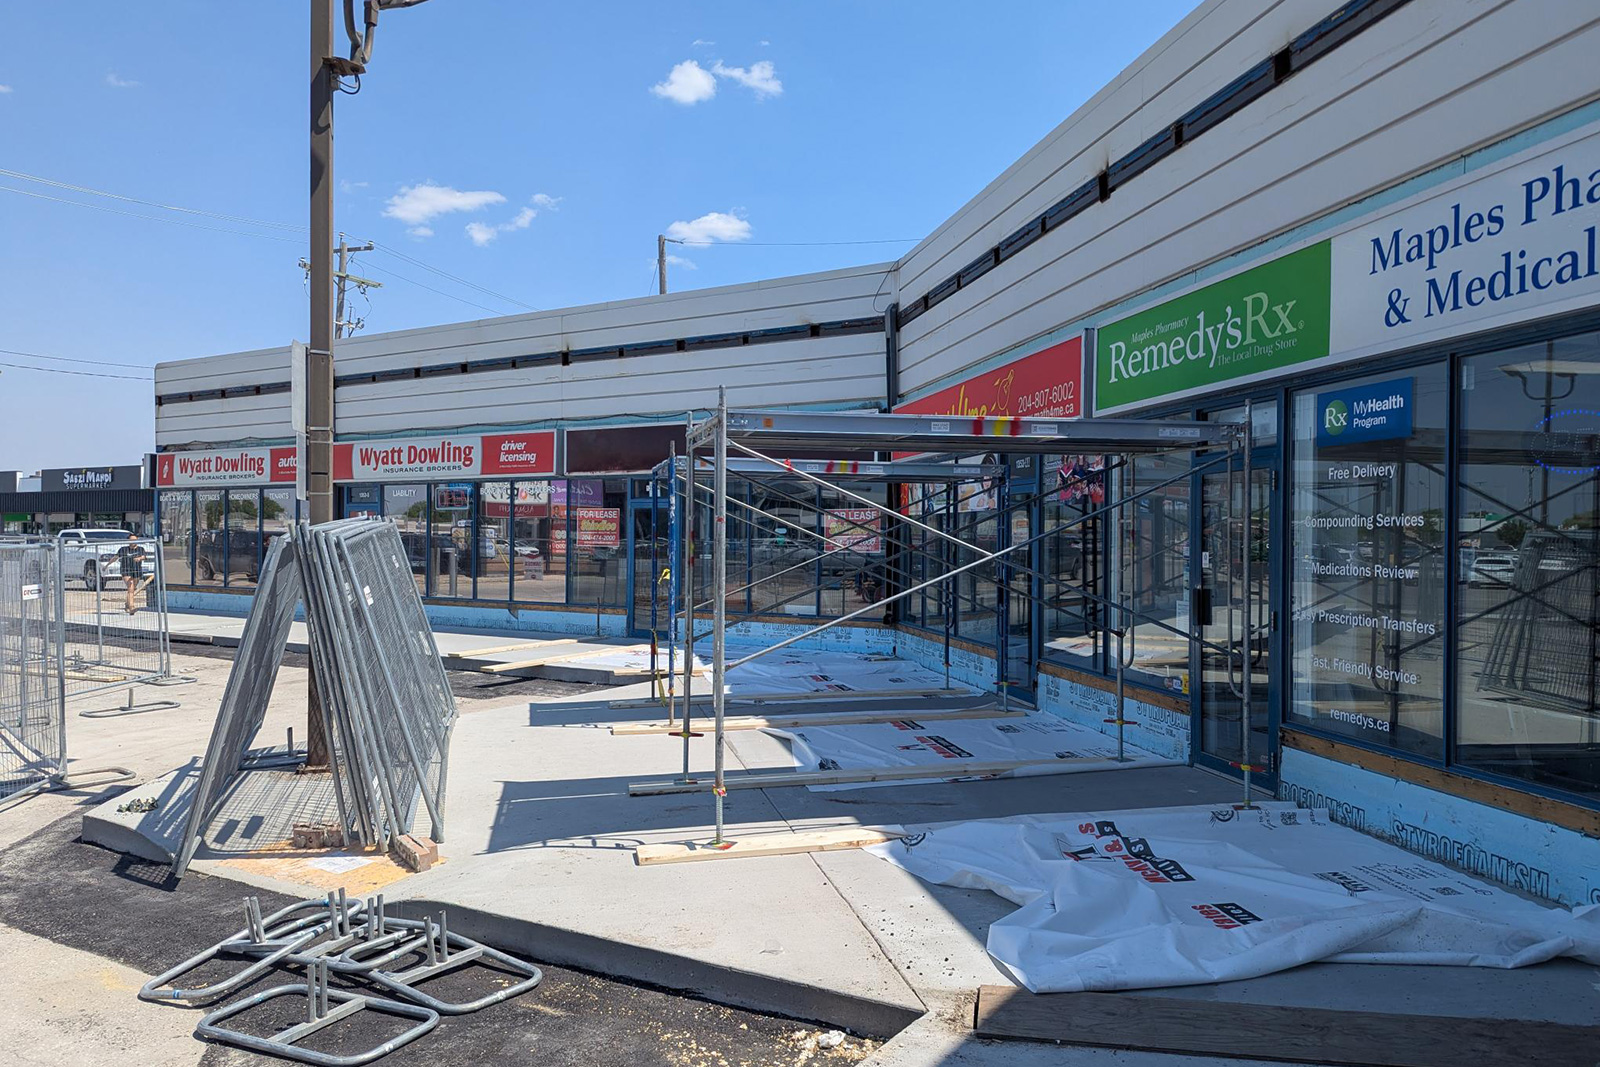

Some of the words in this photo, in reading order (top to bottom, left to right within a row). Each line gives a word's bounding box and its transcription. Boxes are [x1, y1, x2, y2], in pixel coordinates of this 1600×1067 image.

[1369, 203, 1504, 275] Maples
[1384, 288, 1411, 327] &
[1424, 226, 1600, 318] Medical
[1131, 328, 1154, 345] Maples
[1154, 316, 1189, 335] Pharmacy
[1217, 354, 1230, 367] The
[1232, 346, 1251, 362] Local
[1253, 344, 1273, 357] Drug
[1275, 337, 1298, 351] Store
[1018, 381, 1074, 413] 204-807-6002
[1353, 394, 1404, 416] MyHealth
[1325, 407, 1348, 429] Rx
[1353, 416, 1387, 429] Program
[501, 440, 527, 451] driver
[360, 446, 403, 471] Wyatt
[407, 441, 474, 467] Dowling
[500, 450, 537, 464] licensing
[179, 457, 212, 478] Wyatt
[215, 453, 264, 475] Dowling
[383, 466, 424, 474] INSURANCE
[427, 464, 462, 472] BROKERS
[1328, 466, 1349, 480] Free
[1352, 464, 1396, 479] Delivery
[66, 482, 108, 490] SUPERMARKET
[392, 489, 417, 498] LIABILITY
[229, 492, 259, 500] HOMEOWNERS
[269, 492, 290, 500] TENANTS
[580, 510, 594, 518] FOR
[595, 510, 617, 518] LEASE
[848, 511, 877, 520] LEASE
[1305, 514, 1374, 530] Compounding
[1376, 513, 1425, 527] Services
[1311, 562, 1371, 577] Medications
[1374, 564, 1415, 580] Review
[1318, 610, 1379, 628] Prescription
[1381, 616, 1436, 635] Transfers
[1333, 658, 1373, 679] Friendly
[1375, 665, 1417, 685] Service
[1330, 708, 1390, 732] remedys.ca
